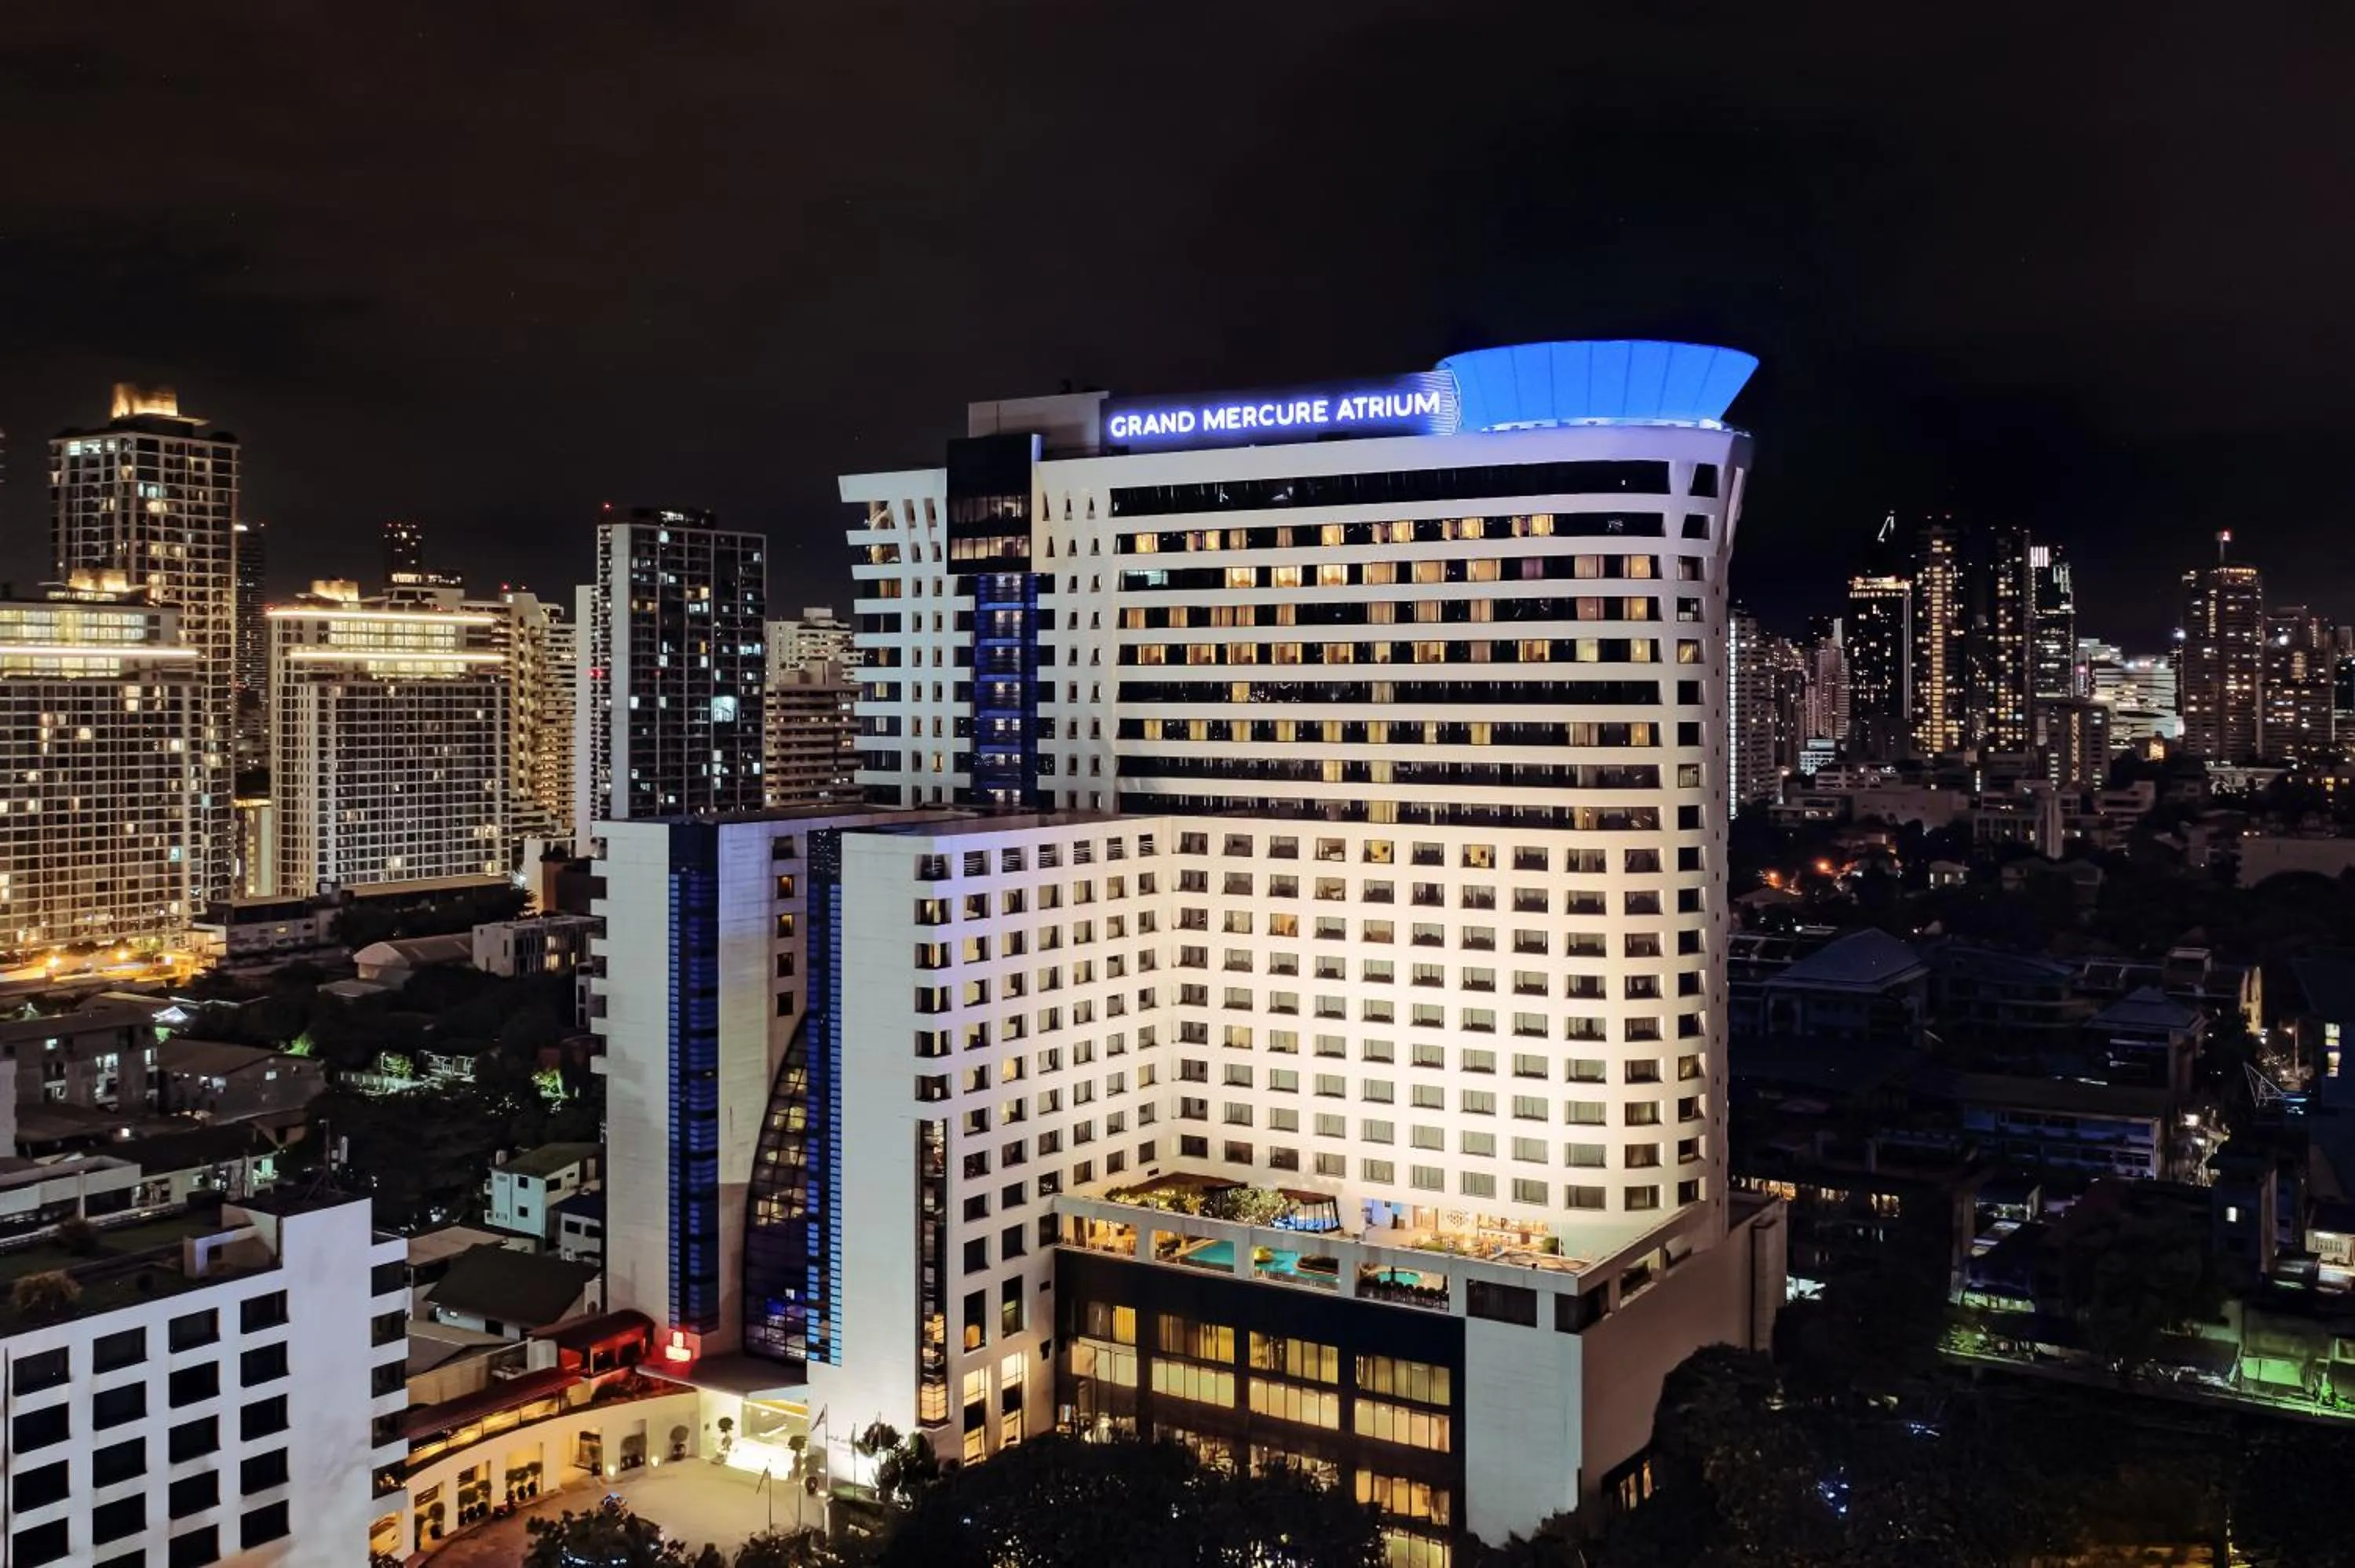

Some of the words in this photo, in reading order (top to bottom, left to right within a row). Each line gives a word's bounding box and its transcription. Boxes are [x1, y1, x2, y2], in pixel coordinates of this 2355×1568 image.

[1110, 411, 1196, 438] GRAND
[1203, 400, 1329, 431] MERCURE
[1336, 392, 1441, 421] ATRIUM
